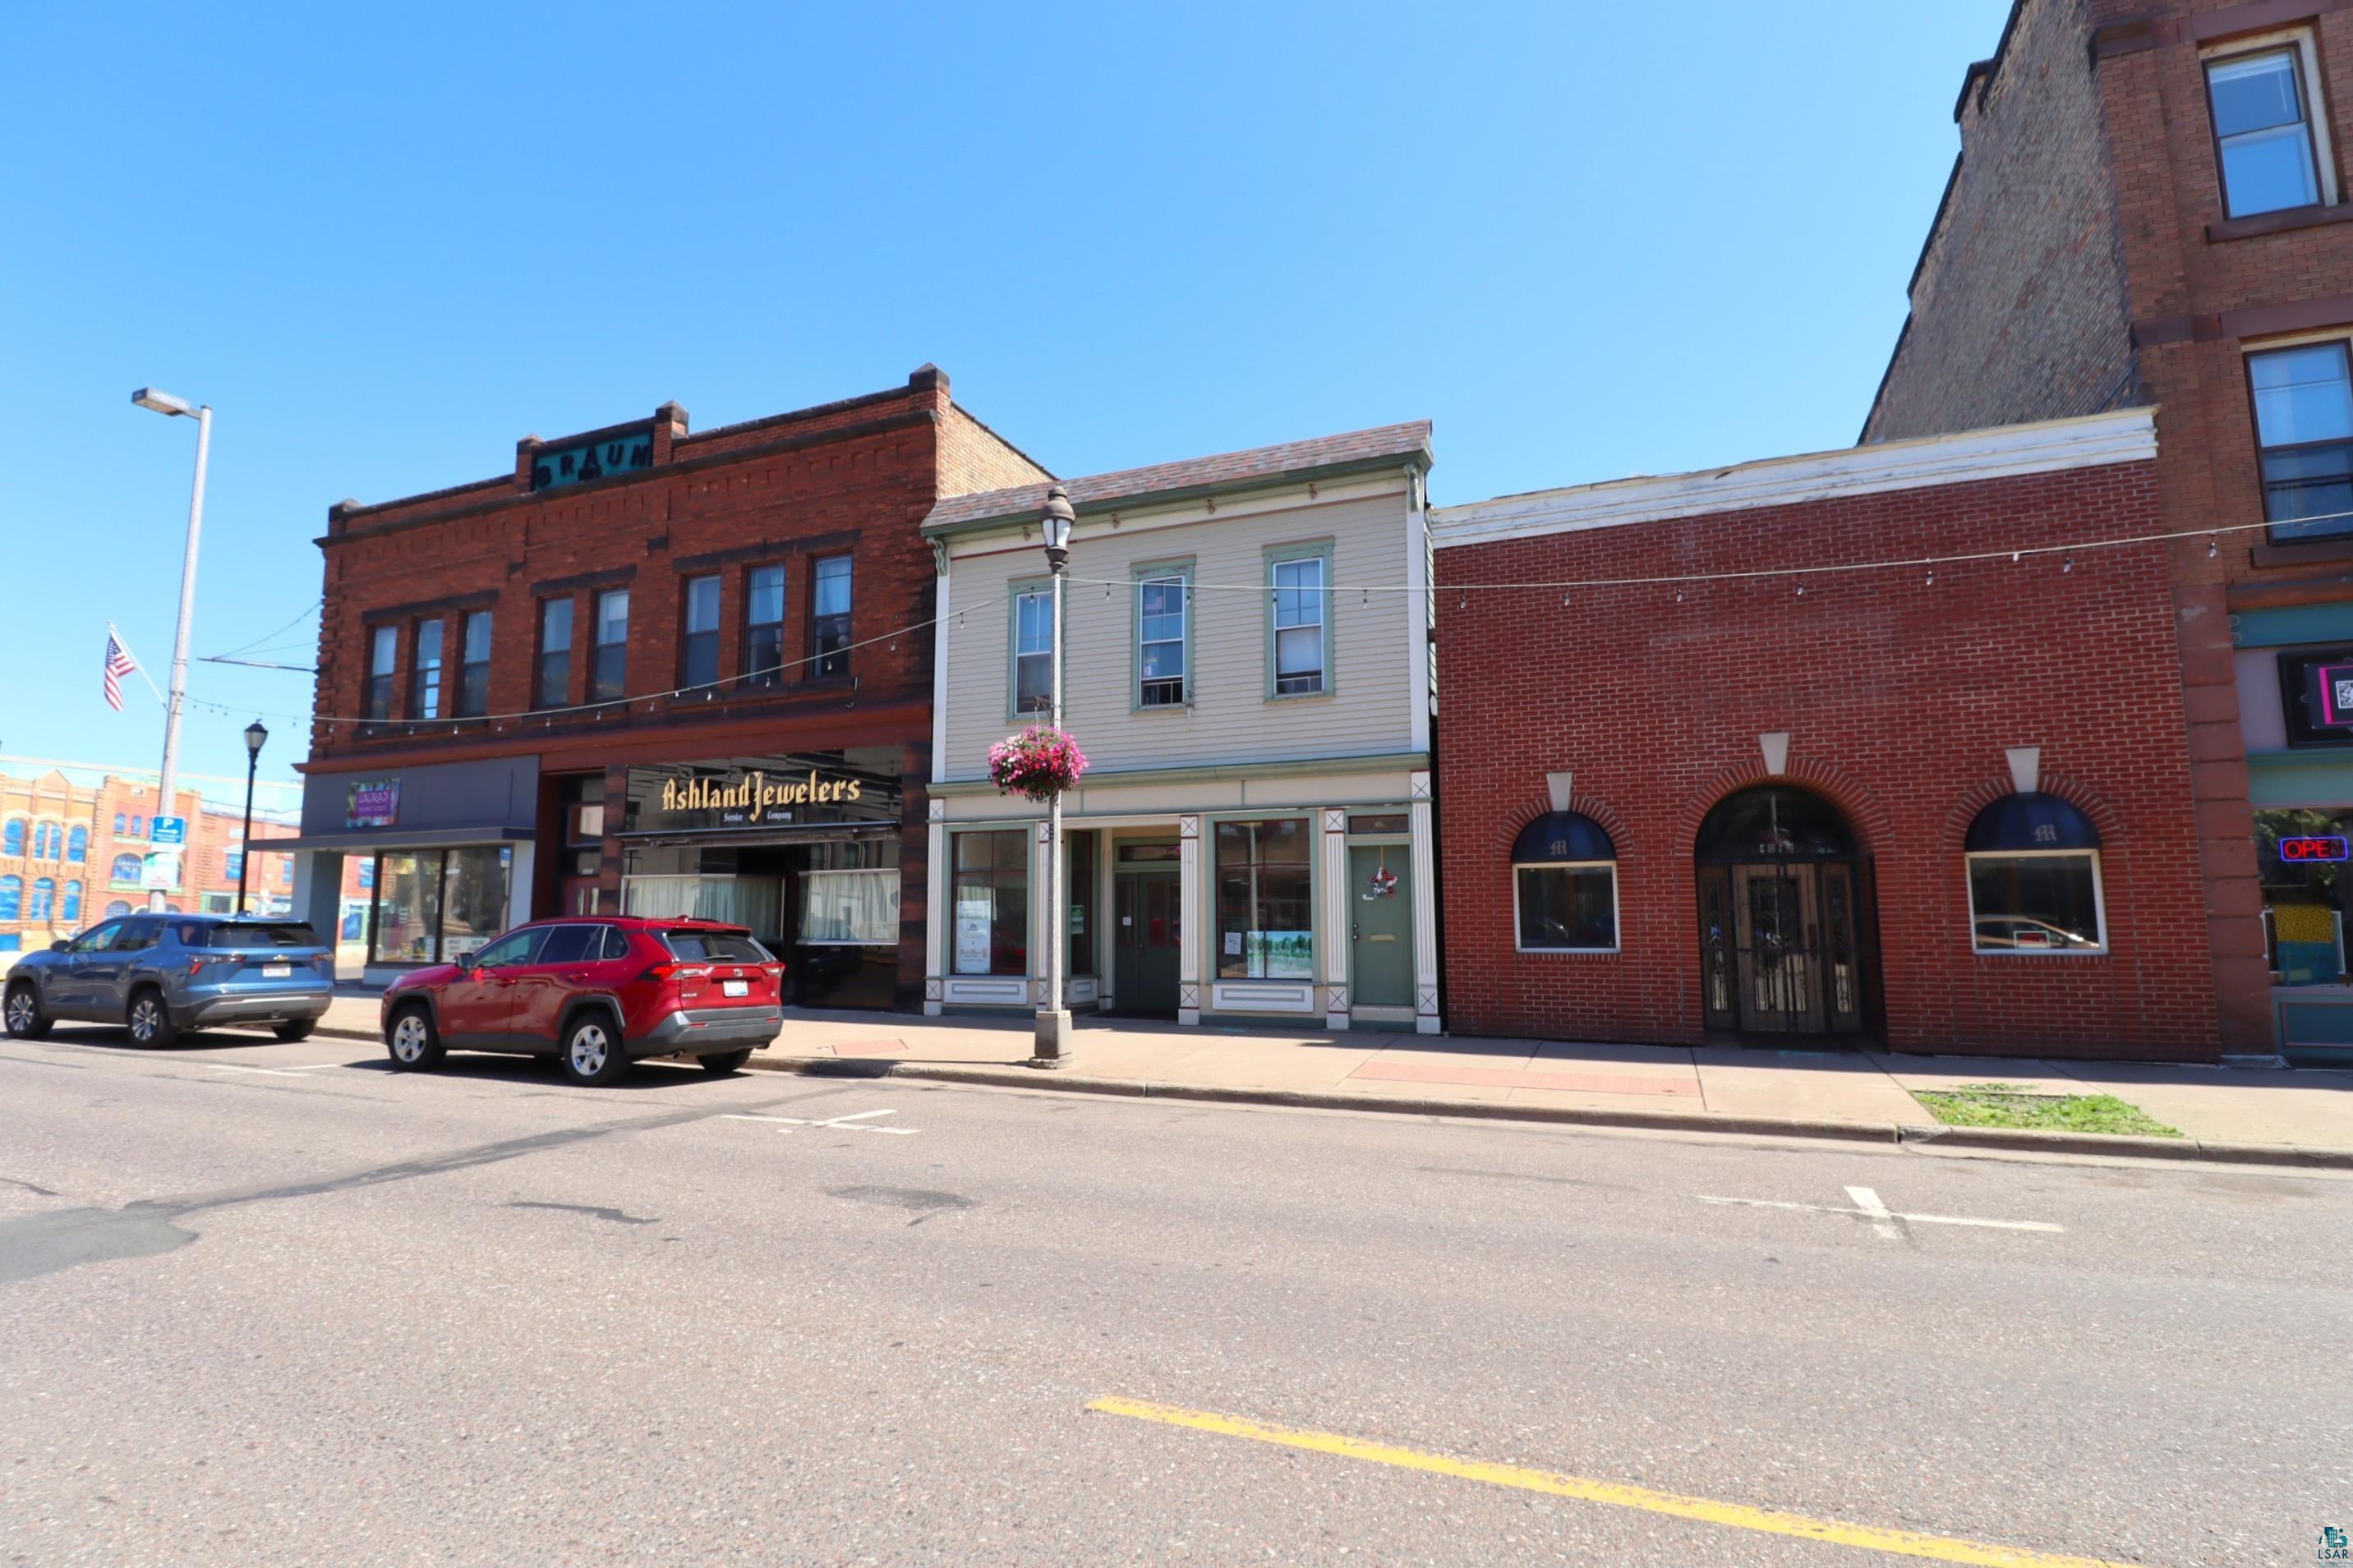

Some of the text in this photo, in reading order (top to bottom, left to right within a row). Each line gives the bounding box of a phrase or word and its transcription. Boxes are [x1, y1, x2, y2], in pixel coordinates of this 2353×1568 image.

[661, 770, 861, 822] Ashland Jewelers
[724, 810, 792, 822] Service Company
[162, 818, 175, 829] P
